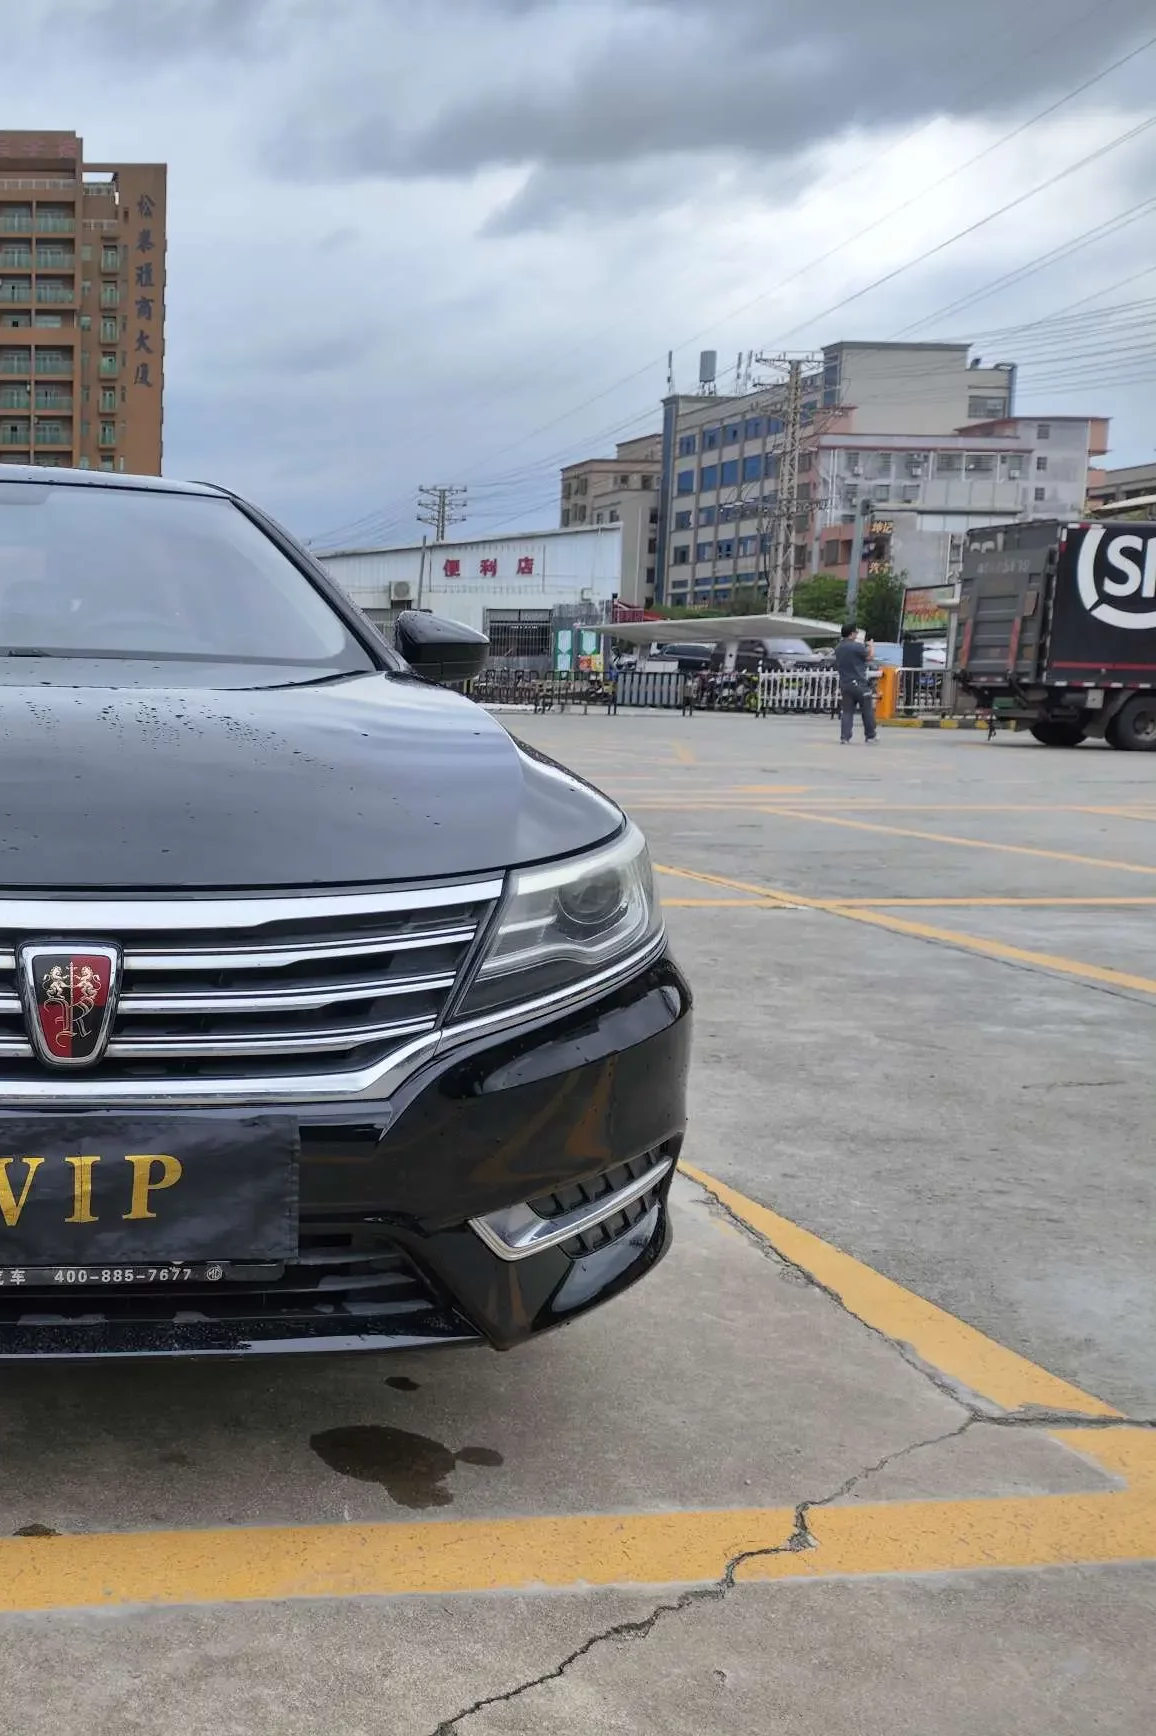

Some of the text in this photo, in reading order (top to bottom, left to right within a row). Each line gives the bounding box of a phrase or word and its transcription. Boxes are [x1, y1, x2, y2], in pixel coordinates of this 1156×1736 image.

[443, 556, 534, 578] 便利店
[53, 1266, 193, 1284] 400-885-7677
